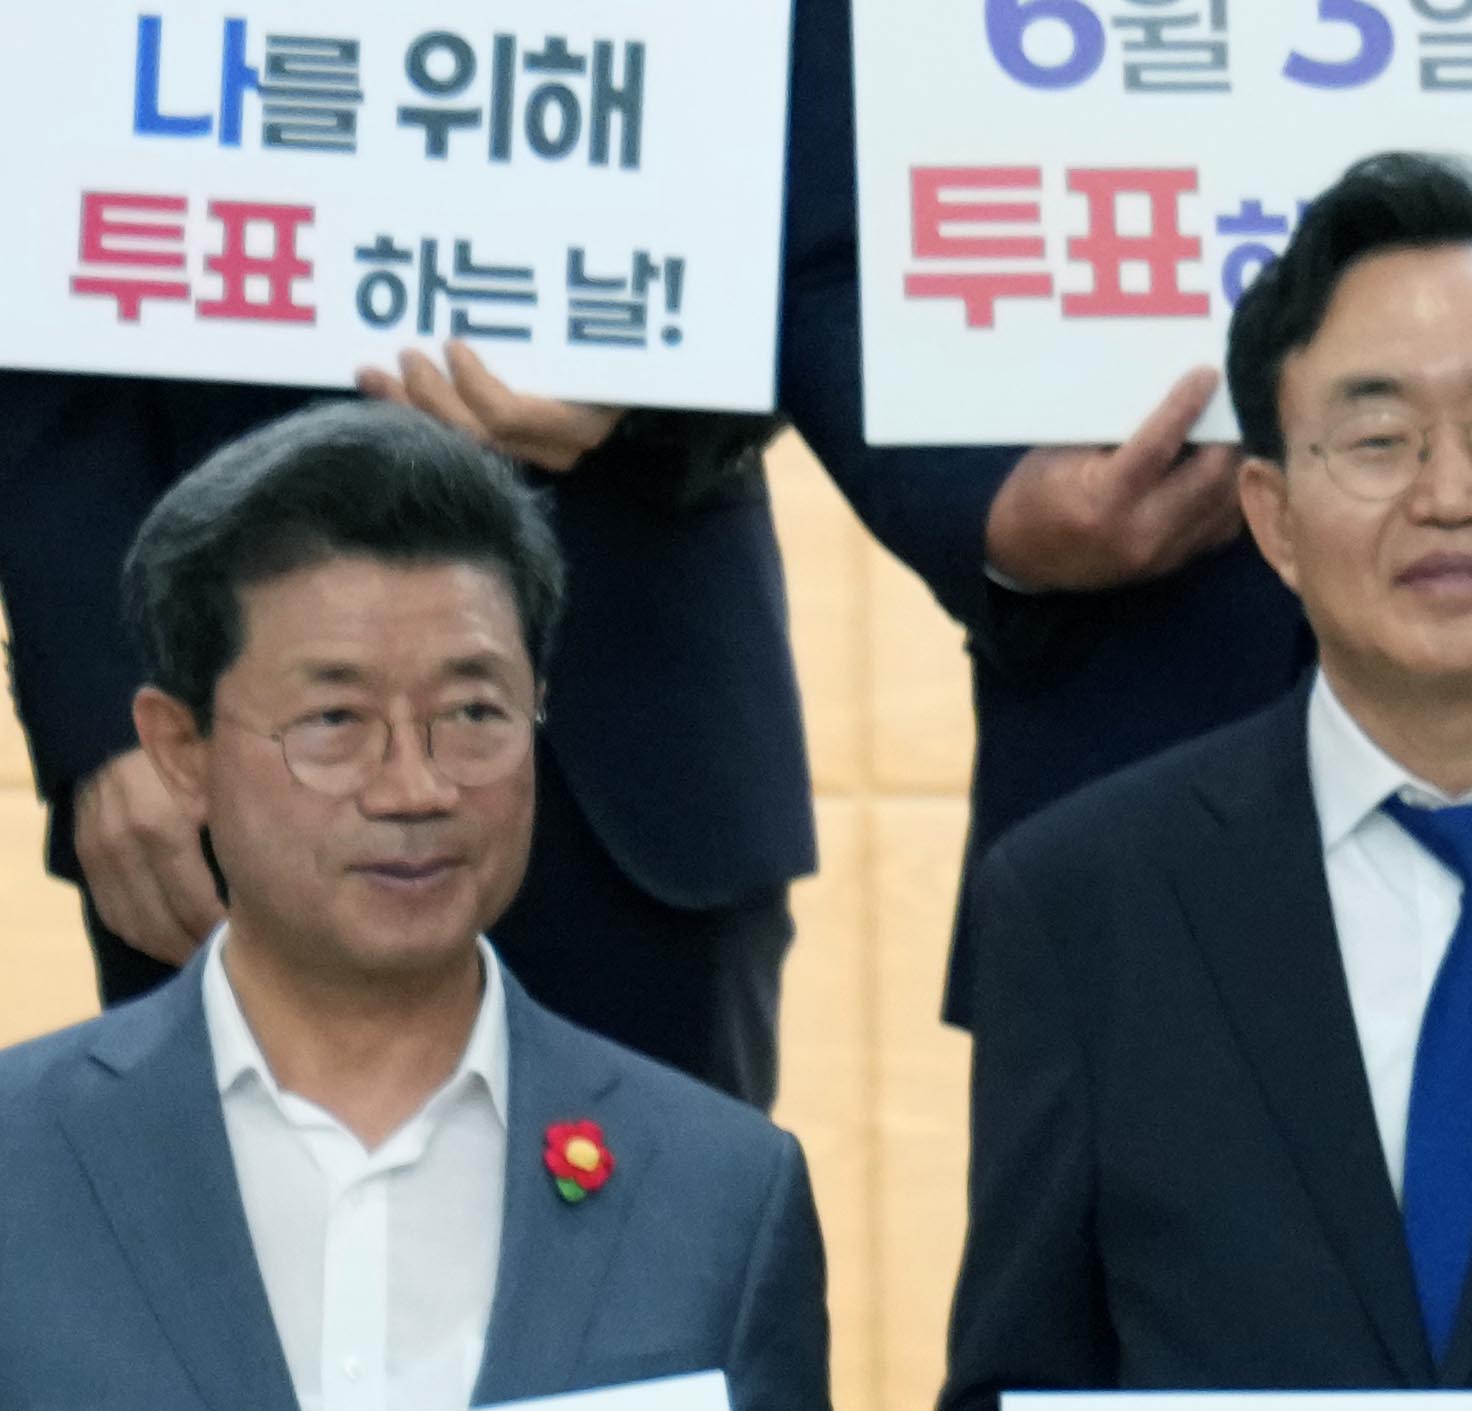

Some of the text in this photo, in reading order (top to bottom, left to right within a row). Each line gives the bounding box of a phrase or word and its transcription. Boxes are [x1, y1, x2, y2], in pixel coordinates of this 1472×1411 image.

[134, 14, 646, 170] 나를 위해
[70, 190, 686, 347] 투표 하는 날!
